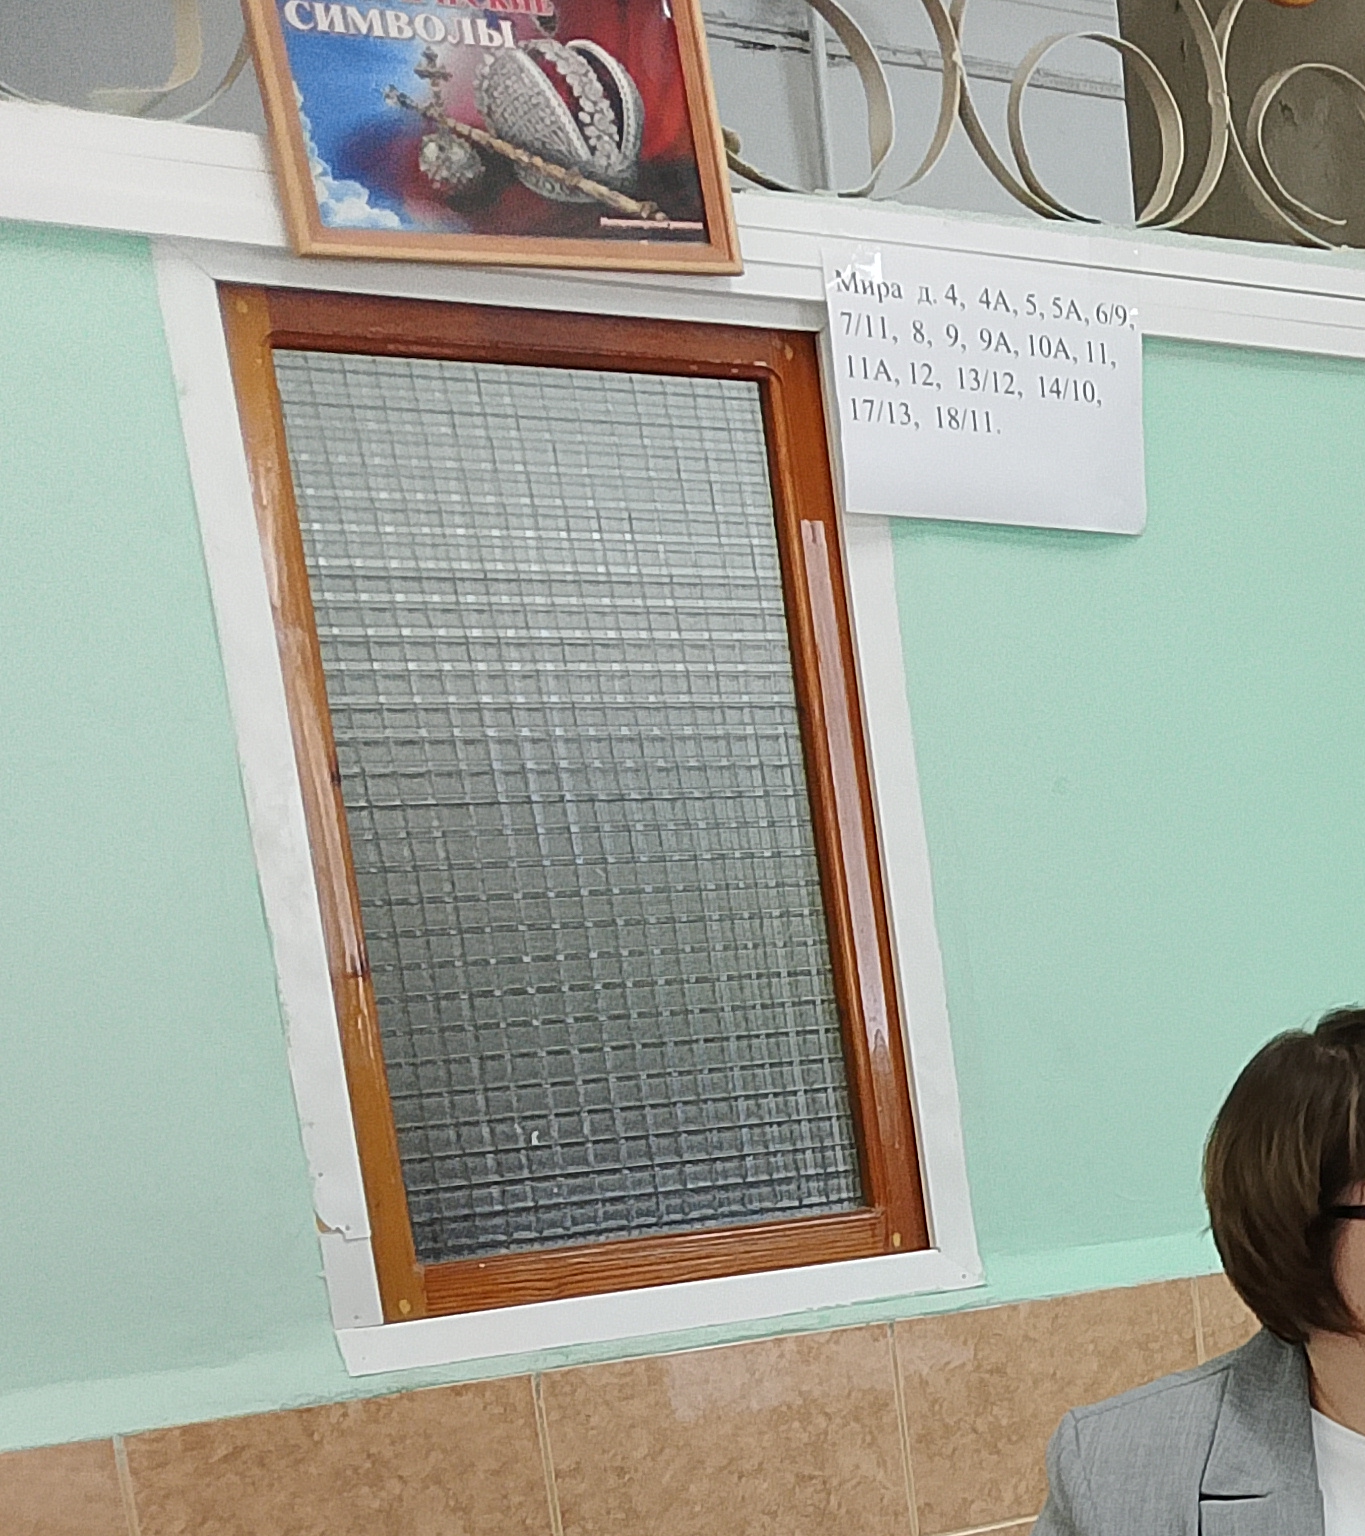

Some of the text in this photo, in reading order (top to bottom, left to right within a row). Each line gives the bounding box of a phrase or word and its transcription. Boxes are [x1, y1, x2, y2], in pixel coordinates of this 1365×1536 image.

[283, 0, 518, 50] СИМВОЛЫ
[836, 270, 903, 304] Мира
[917, 286, 938, 306] д.
[944, 284, 966, 312] 4,
[978, 288, 1018, 317] 4А,
[1025, 293, 1045, 320] 5,
[1052, 297, 1090, 326] 5А,
[840, 312, 1117, 370] 7/11, 8, 9, 9А, 10А, 11,
[848, 355, 1103, 408] 11А, 12, 13/12, 14/10,
[851, 397, 1002, 435] 17/13, 18/11.
